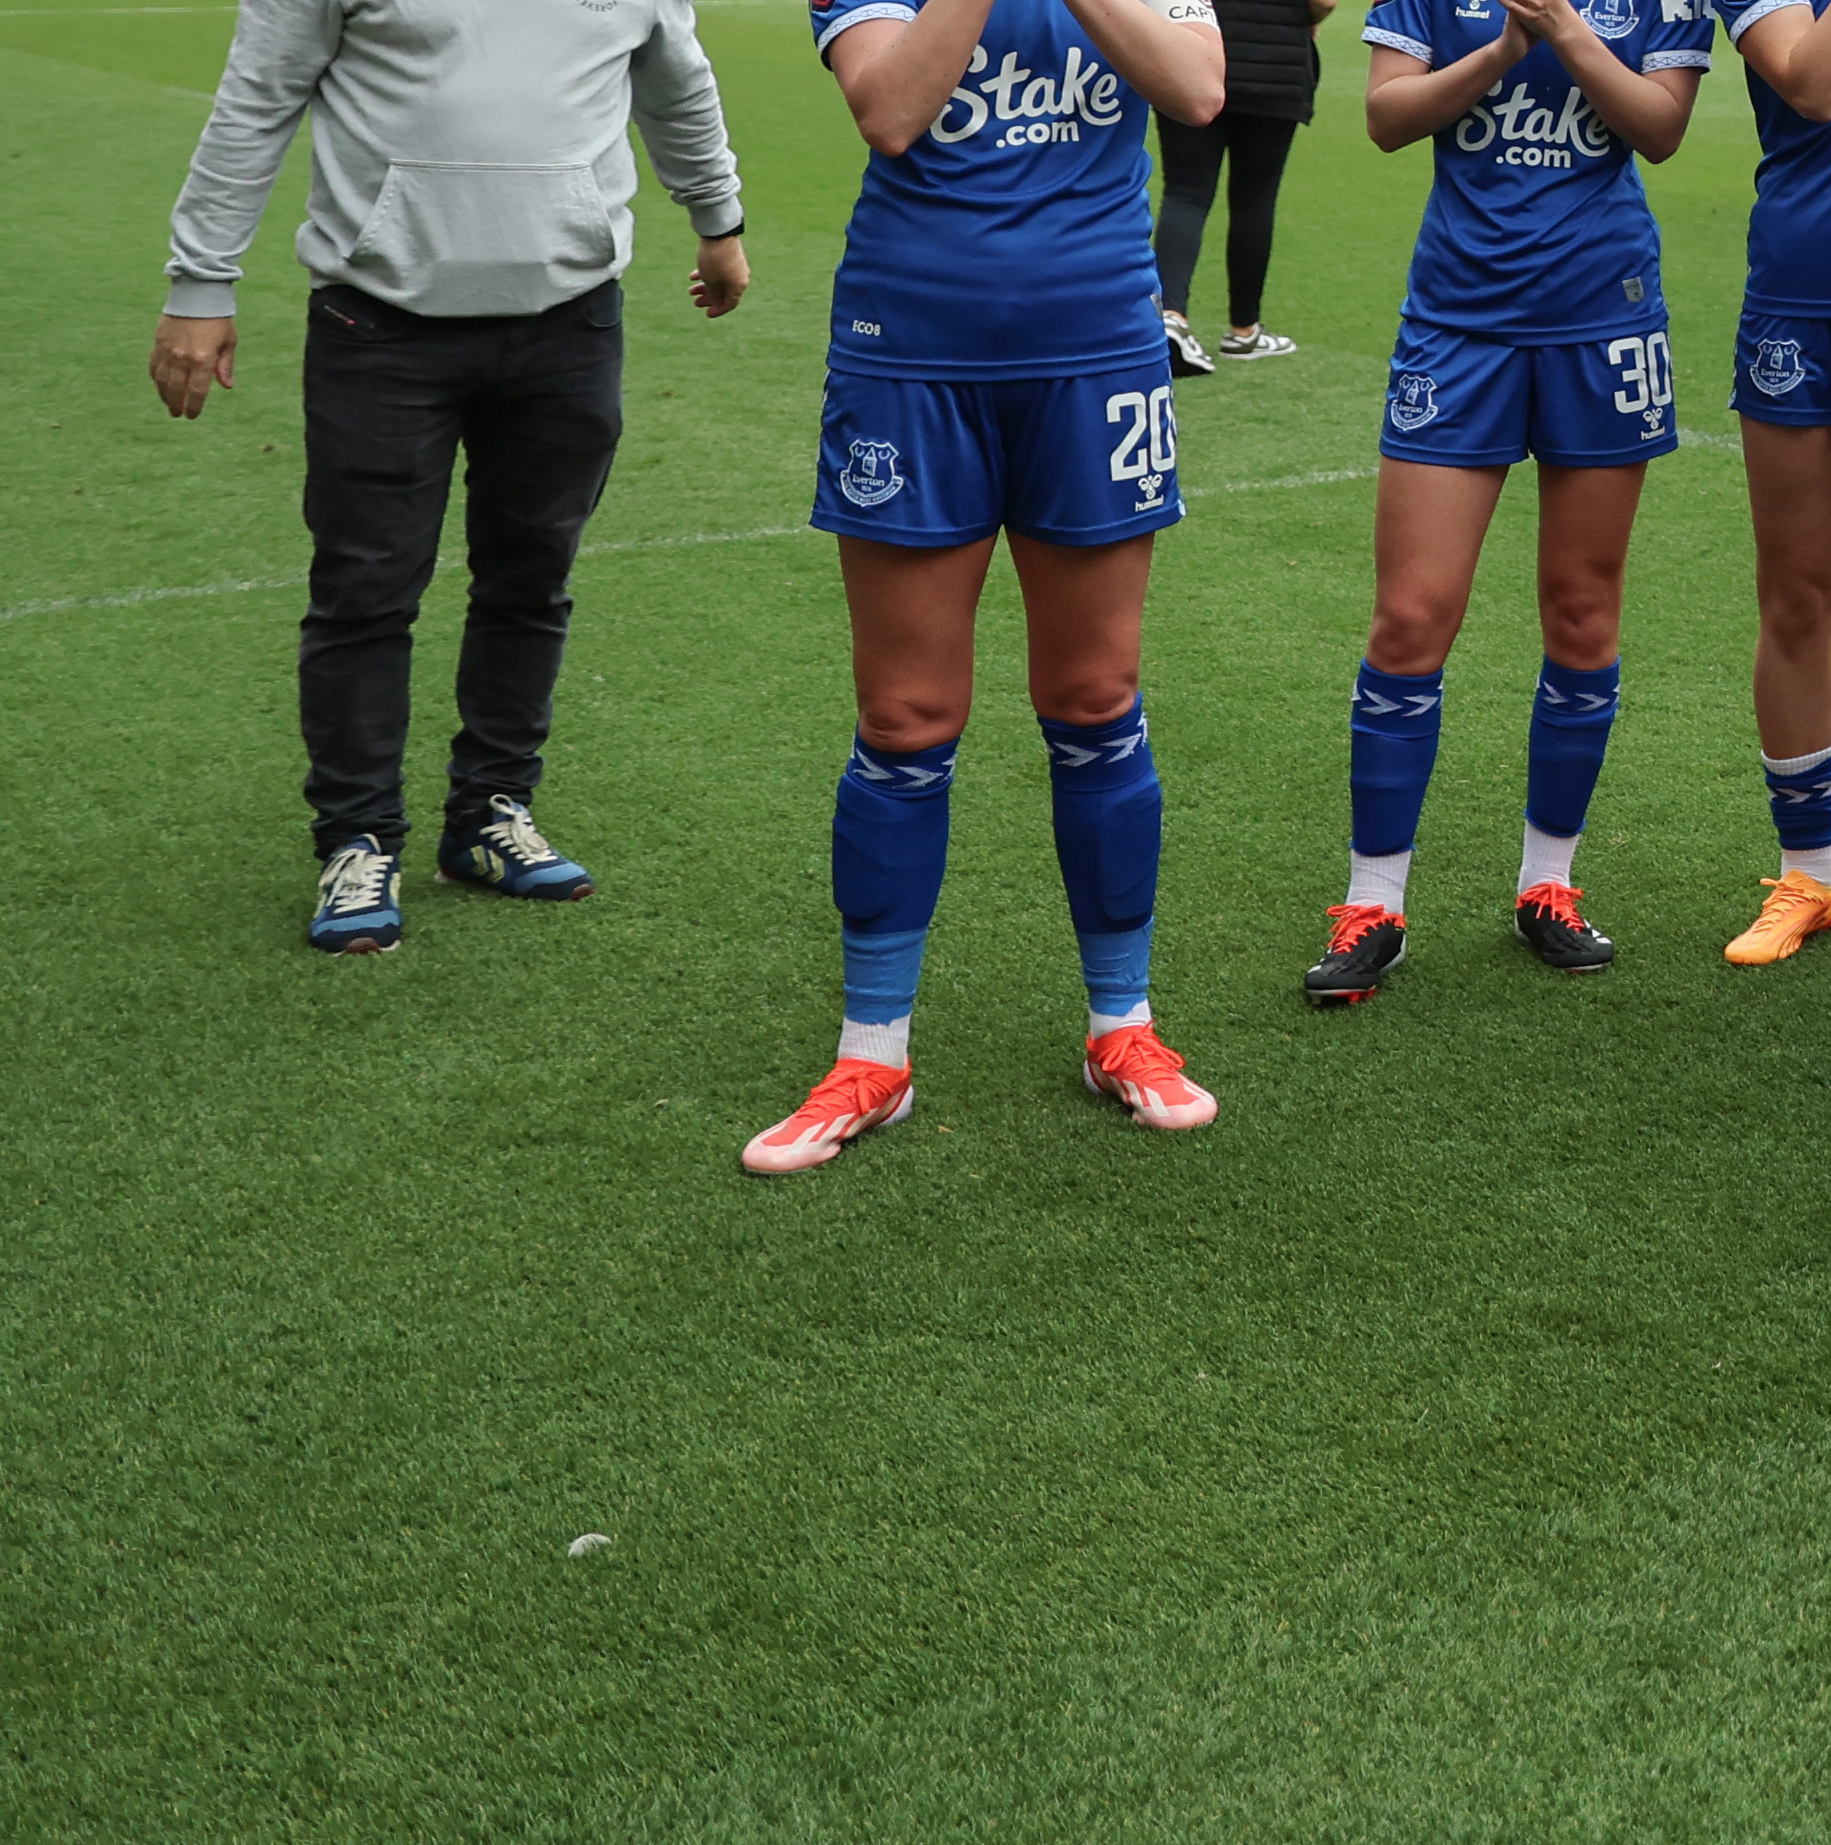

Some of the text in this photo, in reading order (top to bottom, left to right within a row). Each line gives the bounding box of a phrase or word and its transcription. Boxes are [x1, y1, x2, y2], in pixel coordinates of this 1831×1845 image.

[1455, 6, 1490, 20] hummel
[1595, 11, 1626, 22] Everton
[929, 46, 1123, 144] Stake
[996, 120, 1079, 148] .com
[1495, 145, 1571, 168] .com
[1607, 331, 1673, 415] 30
[1106, 385, 1177, 483] 20
[852, 473, 886, 488] Everton
[1134, 495, 1165, 513] hummel
